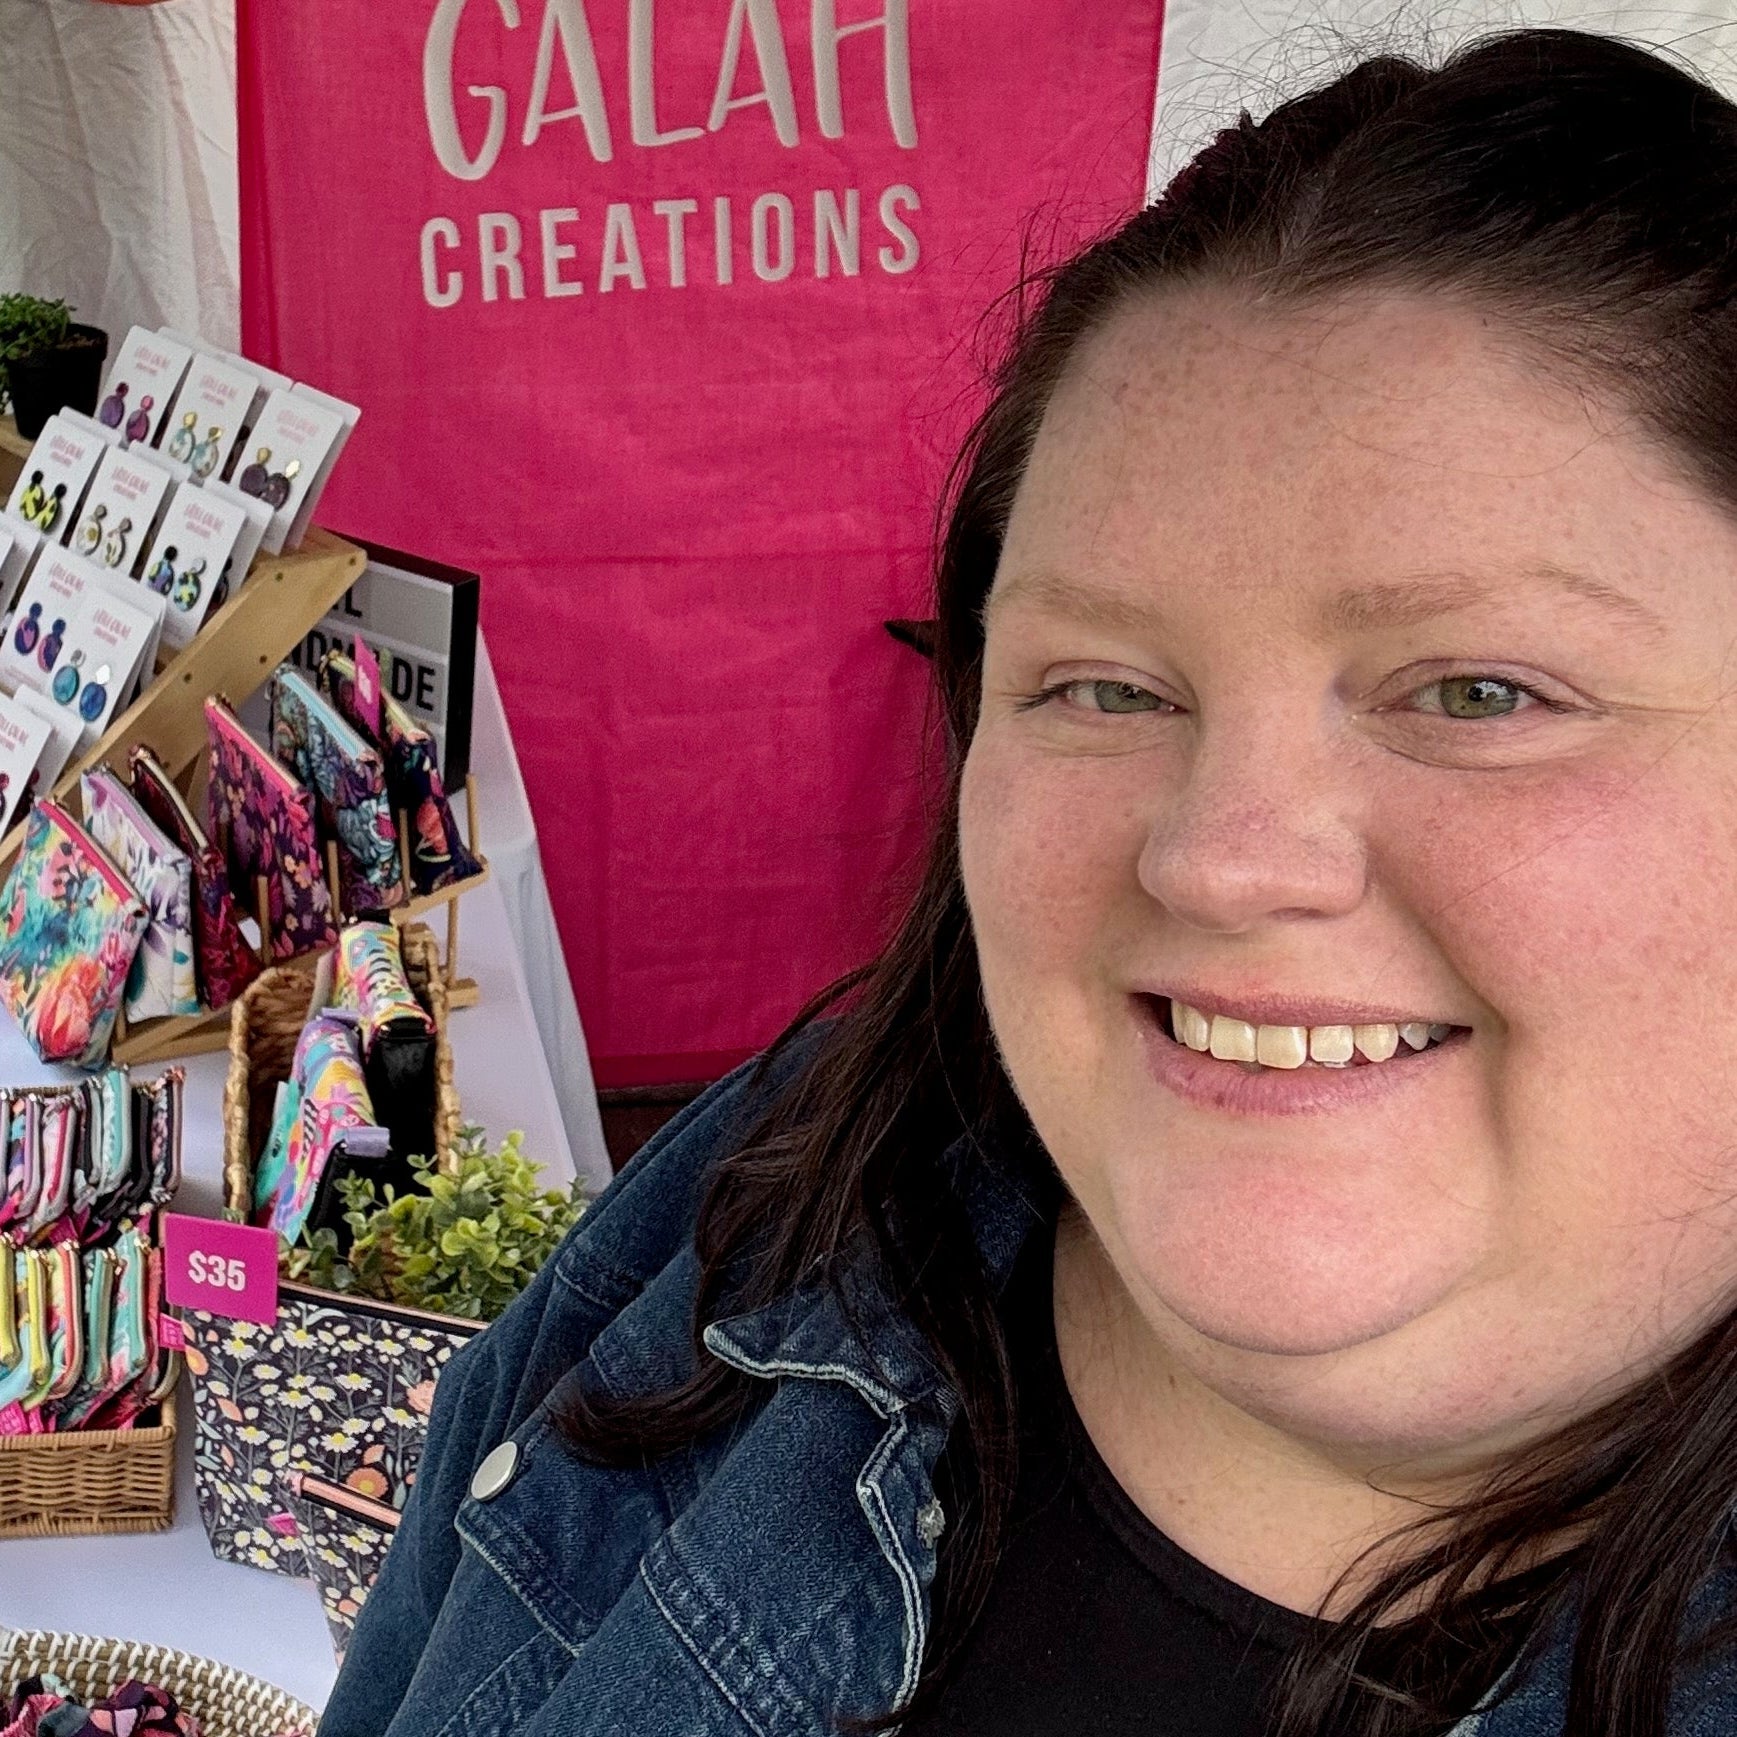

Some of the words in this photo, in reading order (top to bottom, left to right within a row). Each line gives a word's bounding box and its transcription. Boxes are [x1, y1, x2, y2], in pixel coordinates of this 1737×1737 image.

[422, 0, 917, 180] GALAH
[420, 184, 921, 308] CREATIONS
[188, 1250, 246, 1291] $35
